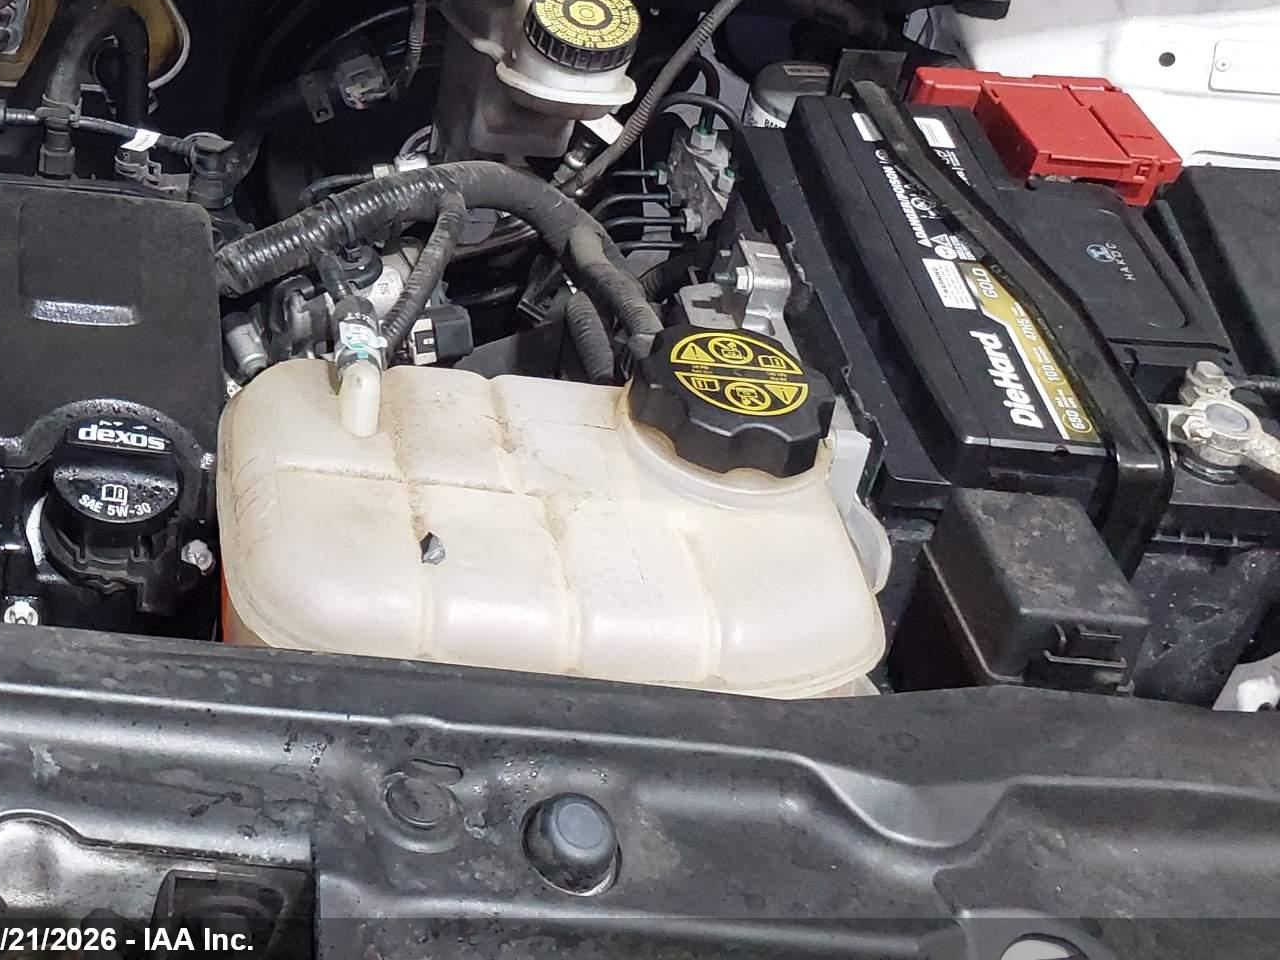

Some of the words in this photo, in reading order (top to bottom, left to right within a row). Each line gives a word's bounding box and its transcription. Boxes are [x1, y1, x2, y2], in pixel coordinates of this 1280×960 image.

[882, 165, 930, 241] DANGER/POISON
[971, 267, 999, 299] GOLD
[969, 330, 1044, 429] DieHard
[1041, 363, 1061, 382] 100
[1065, 409, 1087, 430] 650
[78, 424, 165, 450] dexos
[78, 494, 104, 513] SAE
[107, 502, 152, 517] 5W-30
